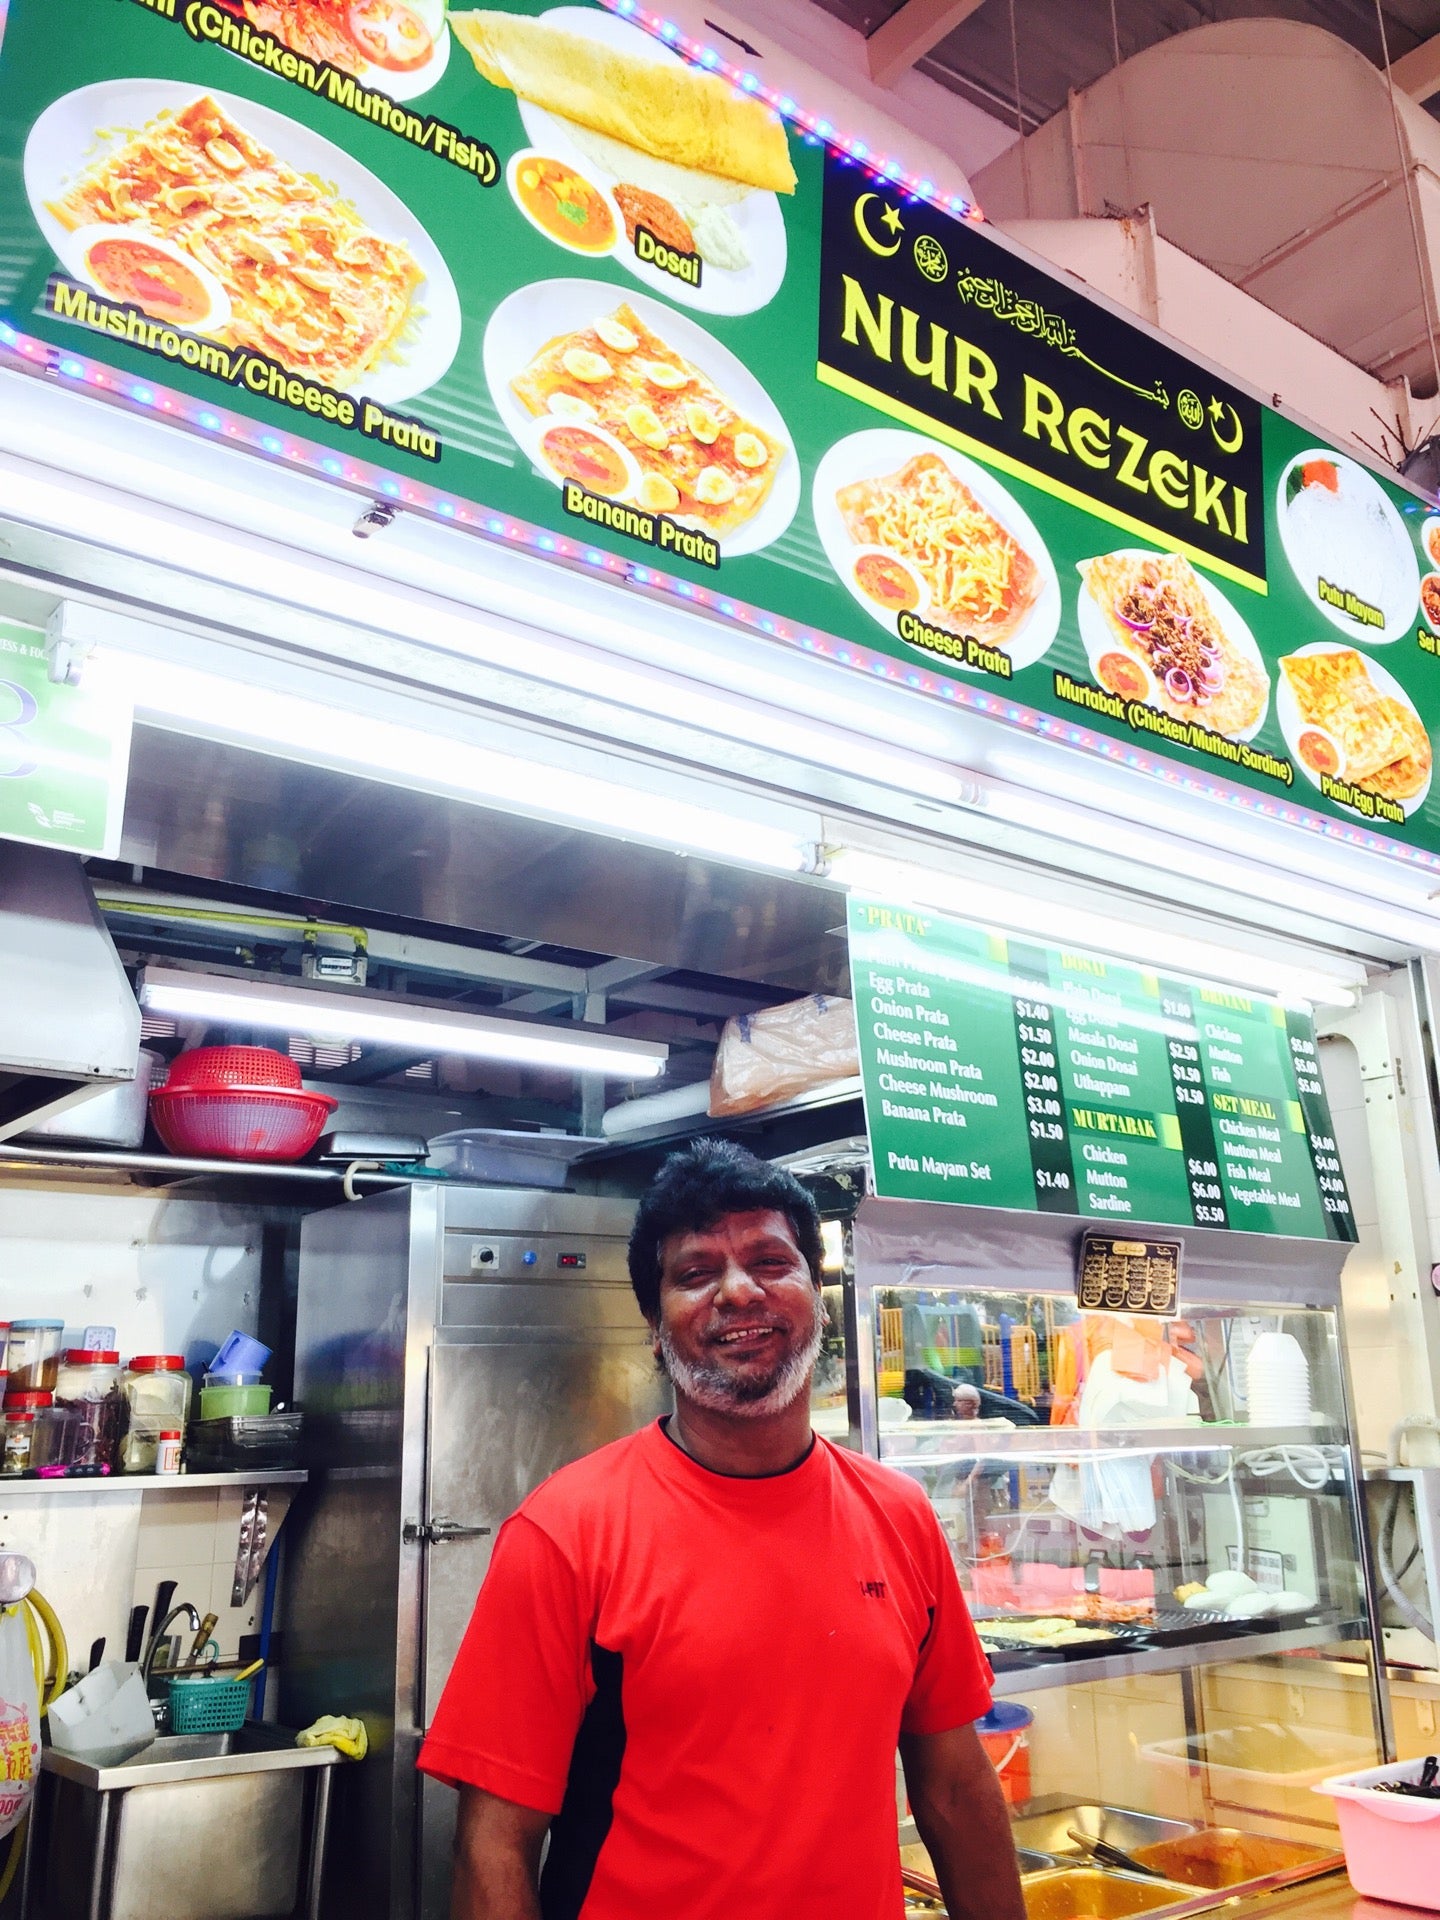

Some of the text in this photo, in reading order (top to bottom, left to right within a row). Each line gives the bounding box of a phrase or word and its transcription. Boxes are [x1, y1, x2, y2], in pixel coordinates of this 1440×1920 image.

[186, 2, 497, 183] (Chicken/Mutton/Fish)
[639, 231, 700, 285] Dosai
[54, 283, 438, 458] Mushroom/Cheese Prata
[841, 274, 1249, 545] NUR REZEKI
[567, 484, 718, 566] Banana Prata
[1346, 593, 1385, 630] Mayam
[901, 614, 1011, 678] Cheese Prata
[1055, 676, 1294, 786] Murtabak (Chicken/Mutton/Sardine)
[1321, 775, 1404, 823] Plain/Egg Prata
[867, 906, 926, 936] PRATA
[869, 972, 931, 998] Egg Prata
[871, 997, 950, 1026] Onion Prata
[1016, 1000, 1049, 1021] $1.40
[873, 1022, 958, 1051] Cheese Prata
[1019, 1023, 1052, 1045] $1.50
[1068, 1026, 1138, 1054] Masala Dosai
[877, 1048, 983, 1080] Mushroom Prata
[1021, 1047, 1055, 1069] $2.00
[1070, 1050, 1138, 1076] Onion Dosai
[879, 1073, 998, 1107] Cheese Mushroom
[1024, 1070, 1058, 1093] $2.00
[882, 1099, 967, 1127] Banana Prata
[1027, 1095, 1061, 1116] $3.00
[1212, 1093, 1276, 1121] SET MEAL
[1030, 1119, 1063, 1140] $1.50
[1072, 1107, 1158, 1139] MURTABAK
[1219, 1118, 1281, 1143] Chicken Meal
[1082, 1144, 1128, 1165] Chicken
[1223, 1140, 1282, 1164] Mutton Meal
[888, 1152, 992, 1181] Putu Mayam Set
[1036, 1169, 1070, 1189] $1.40
[1086, 1168, 1128, 1189] Mutton
[1188, 1158, 1218, 1177] $6.00
[1226, 1163, 1272, 1183] Fish Meal
[1089, 1192, 1132, 1213] Sardine
[1191, 1181, 1221, 1200] $6.00
[1229, 1185, 1302, 1208] Vegetable Meal
[1195, 1203, 1225, 1223] $5.50
